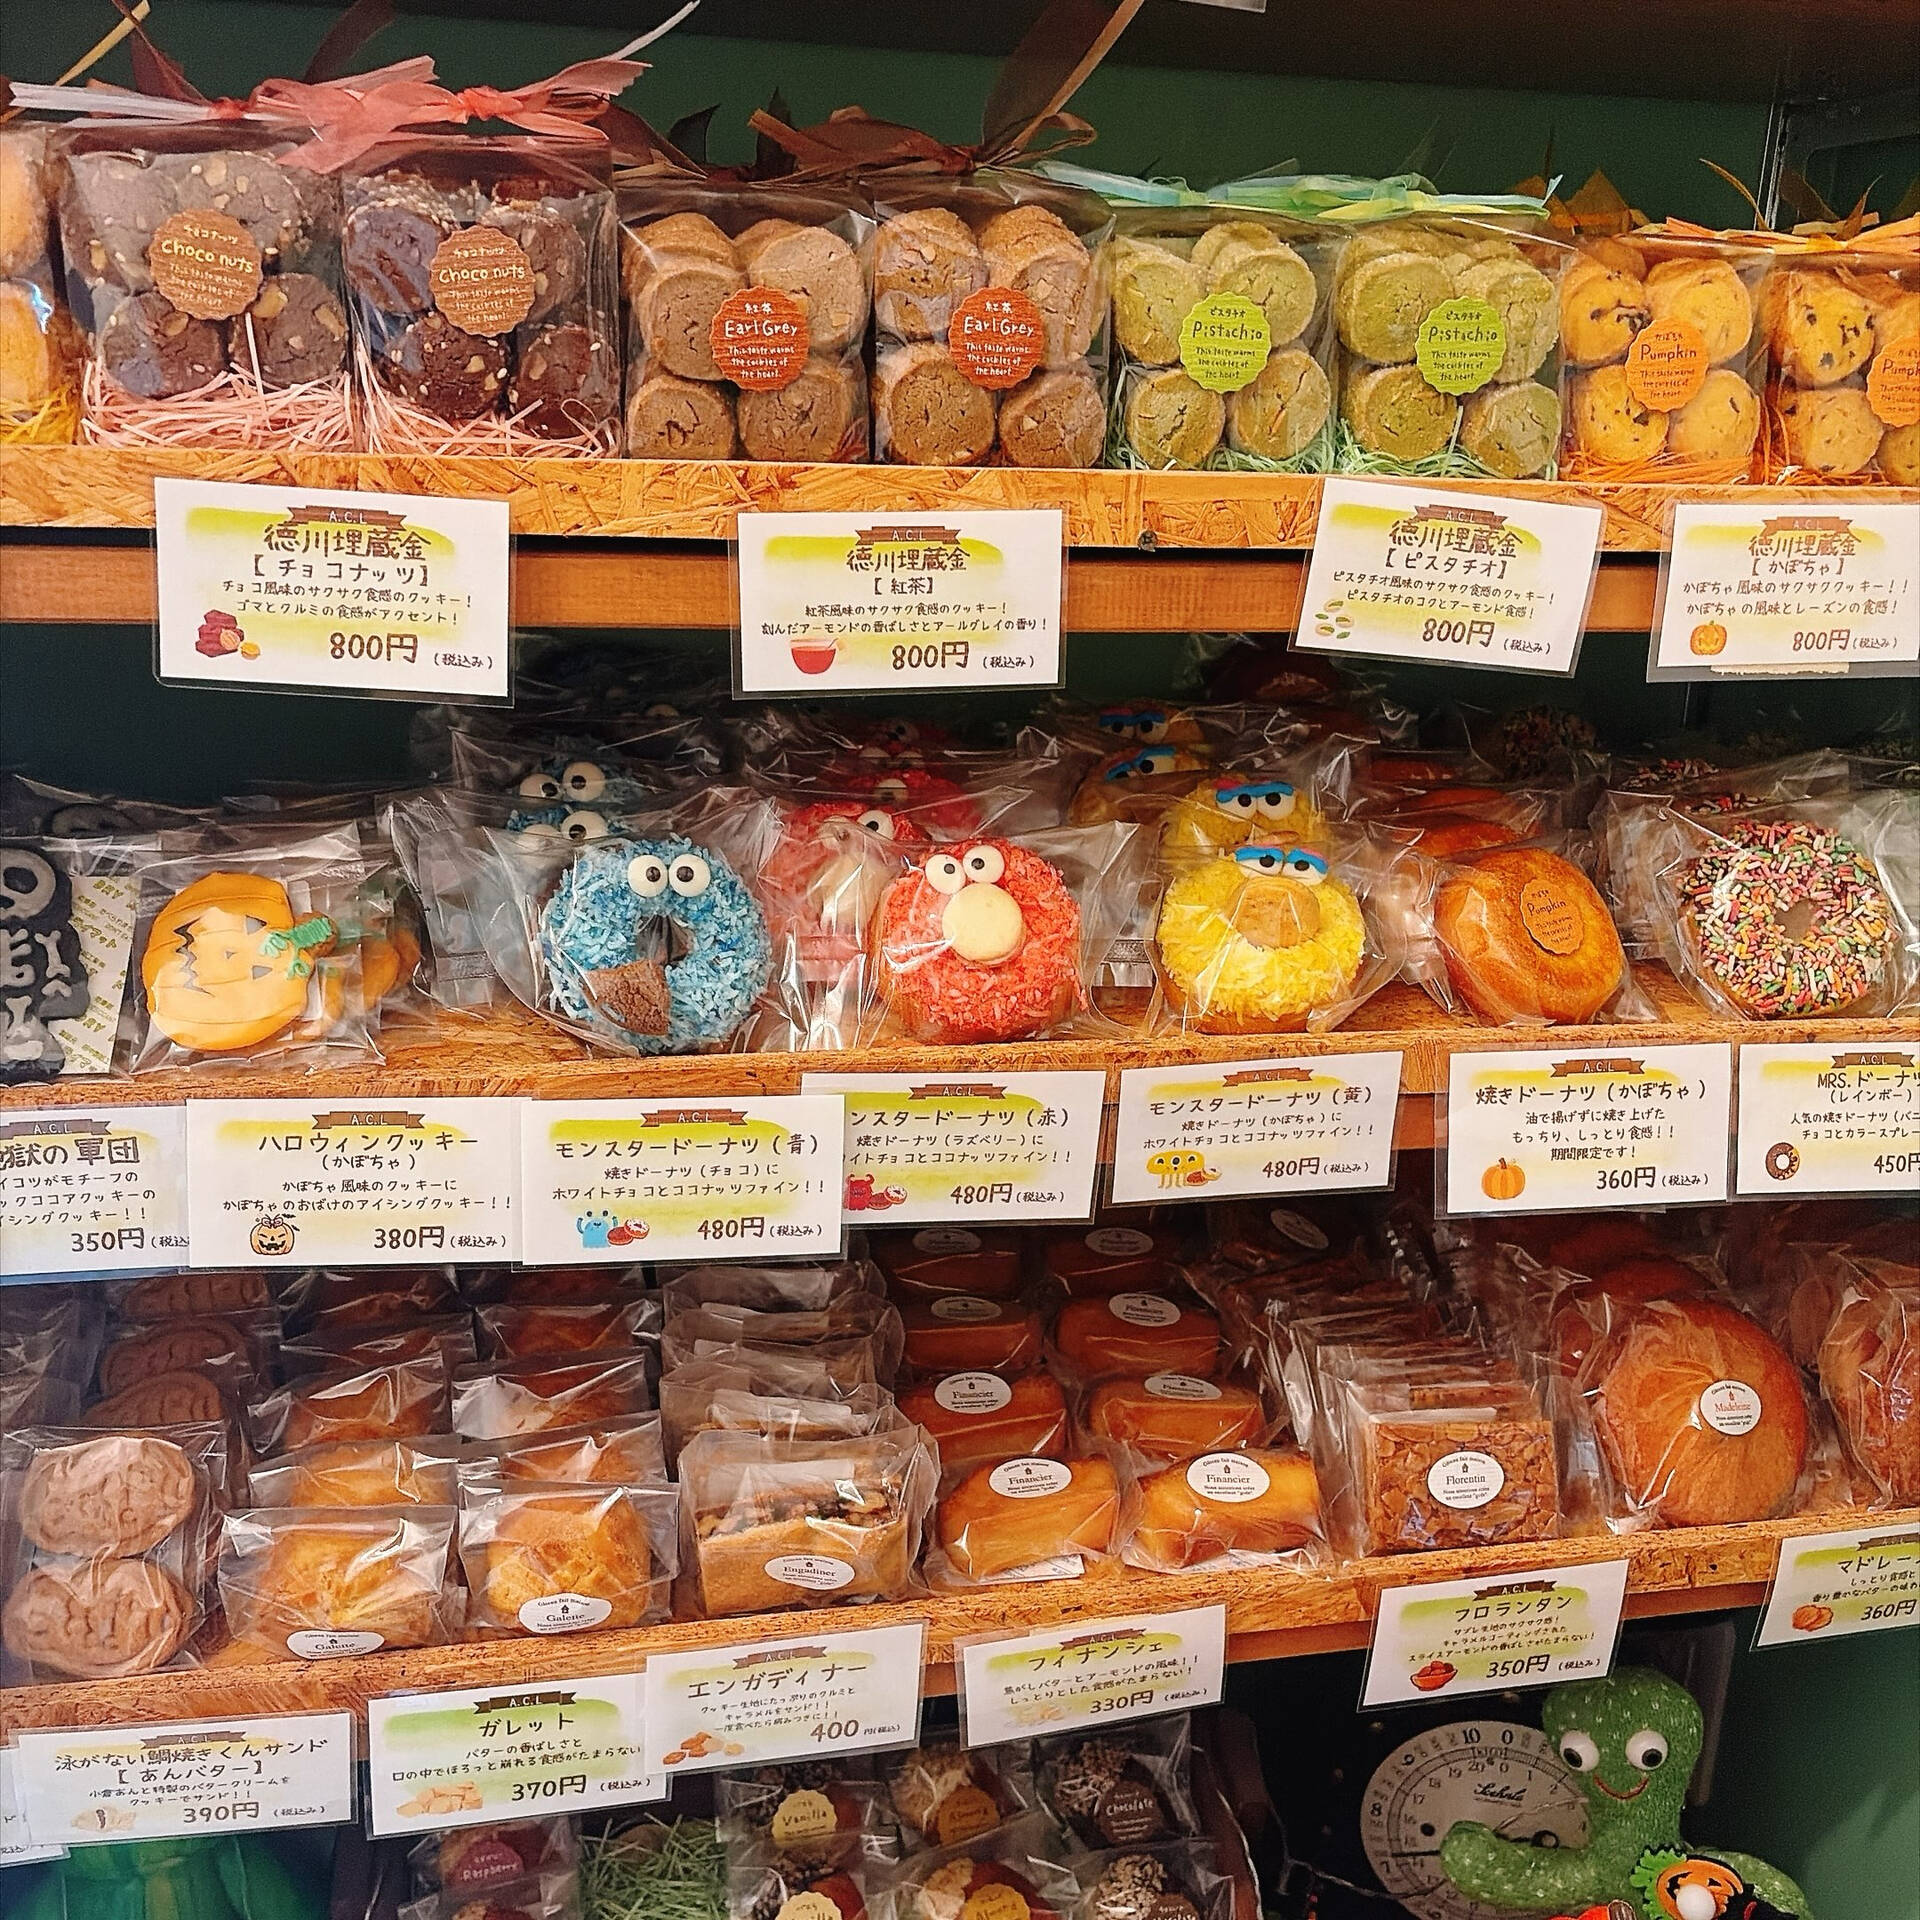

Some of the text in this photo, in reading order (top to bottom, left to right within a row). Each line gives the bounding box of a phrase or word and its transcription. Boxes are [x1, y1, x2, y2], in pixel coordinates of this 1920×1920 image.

[161, 240, 253, 274] Choco nuts
[439, 265, 525, 283] Choco nuts
[1193, 321, 1262, 340] Pistachio
[1429, 326, 1497, 342] Pistachio
[1641, 344, 1696, 362] Pumpkin
[264, 523, 431, 561] 徳川埋蔵金
[1389, 520, 1522, 558] 徳川埋蔵金
[1749, 534, 1861, 557] 徳川埋蔵金
[253, 554, 428, 586] 【チョコナッツ】
[847, 546, 970, 573] 徳川埋蔵金
[1386, 548, 1507, 580] 【ピスタチオ】
[1752, 557, 1845, 576] 【かぼちゃ】
[222, 580, 471, 608] チョコ風味のサクサク食感のクッキー！
[873, 576, 933, 595] 【紅茶】
[1333, 570, 1554, 604] ピスタチオ風味のサクサク食感のクッキー！
[1683, 580, 1908, 595] かぼちゃ風味のサクサククッキー！！
[237, 600, 457, 625] ゴマとクルミの食感がアクセント！
[805, 602, 1006, 617] 紅茶風味のサクサク食感のクッキー！
[1687, 600, 1898, 616] かぼちゃの風味とレーズンの食感！
[1422, 618, 1551, 654] 800円 （税込み）
[1793, 629, 1897, 651] 800円 （税込み）
[330, 632, 492, 669] 800円 （税込み）
[892, 641, 1034, 670] 800円 （税込み）
[1527, 898, 1566, 916] Pumpkin
[1150, 1086, 1372, 1116] モンスタードーナツ（黄）
[1476, 1080, 1706, 1105] 焼きドーナツ（かぼちゃ）
[1830, 1089, 1912, 1103] （レインボー）
[1182, 1112, 1341, 1131] 焼きドーナツ（かぼちゃ）に
[1526, 1108, 1666, 1126] 油で揚げずに焼き上げた
[259, 1132, 478, 1152] ハロウィンクッキー
[556, 1134, 818, 1159] モンスタードーナツ（青）
[856, 1134, 1043, 1148] 焼きドーナツ（ラズベリー）に
[1144, 1124, 1374, 1149] ホワイトチョコとココナッツファイン！！
[1512, 1126, 1674, 1144] もっちり、しっとり食感！！
[322, 1154, 416, 1170] （かぼちゃ）
[842, 1151, 1071, 1165] イトチョコとココナッツファイン！！
[1550, 1146, 1636, 1160] 期間限定です！
[604, 1163, 779, 1180] 焼きドーナツ（チョコ）に
[1262, 1156, 1369, 1178] 480円 （税込み）
[1597, 1166, 1709, 1190] 360円 （税込み）
[283, 1178, 457, 1193] かぼちゃ風味のクッキーに
[552, 1180, 824, 1200] ホワイトチョコとココナッツファイン！！
[950, 1182, 1064, 1205] 480円 （税込み）
[223, 1196, 511, 1212] かぼちゃのおばけのアイシングクッキー！！
[374, 1225, 506, 1249] 380円 （税込み）
[698, 1216, 822, 1240] 480円 （税込み）
[71, 1228, 190, 1252] 350円 （税込
[1207, 1474, 1250, 1483] Financier
[1447, 1475, 1485, 1485] Florentin
[1838, 1554, 1920, 1574] マドレー
[1455, 1596, 1572, 1622] フロランタン
[1861, 1599, 1917, 1621] 360円
[1029, 1640, 1163, 1671] フィナンシェ
[1487, 1653, 1600, 1679] 350円 （税込み）
[688, 1663, 867, 1698] エンガディナー
[1090, 1688, 1208, 1714] 330円 （税込み）
[479, 1712, 574, 1738] ガレット
[1463, 1728, 1513, 1744] 10 0
[55, 1738, 327, 1771] 泳がない鯛焼きくんサンド
[467, 1738, 582, 1760] バターの香ばしさと
[119, 1760, 263, 1784] 【あんバター】
[512, 1774, 650, 1801] 370円 （税込み）
[184, 1801, 326, 1824] 390円 （税込み）
